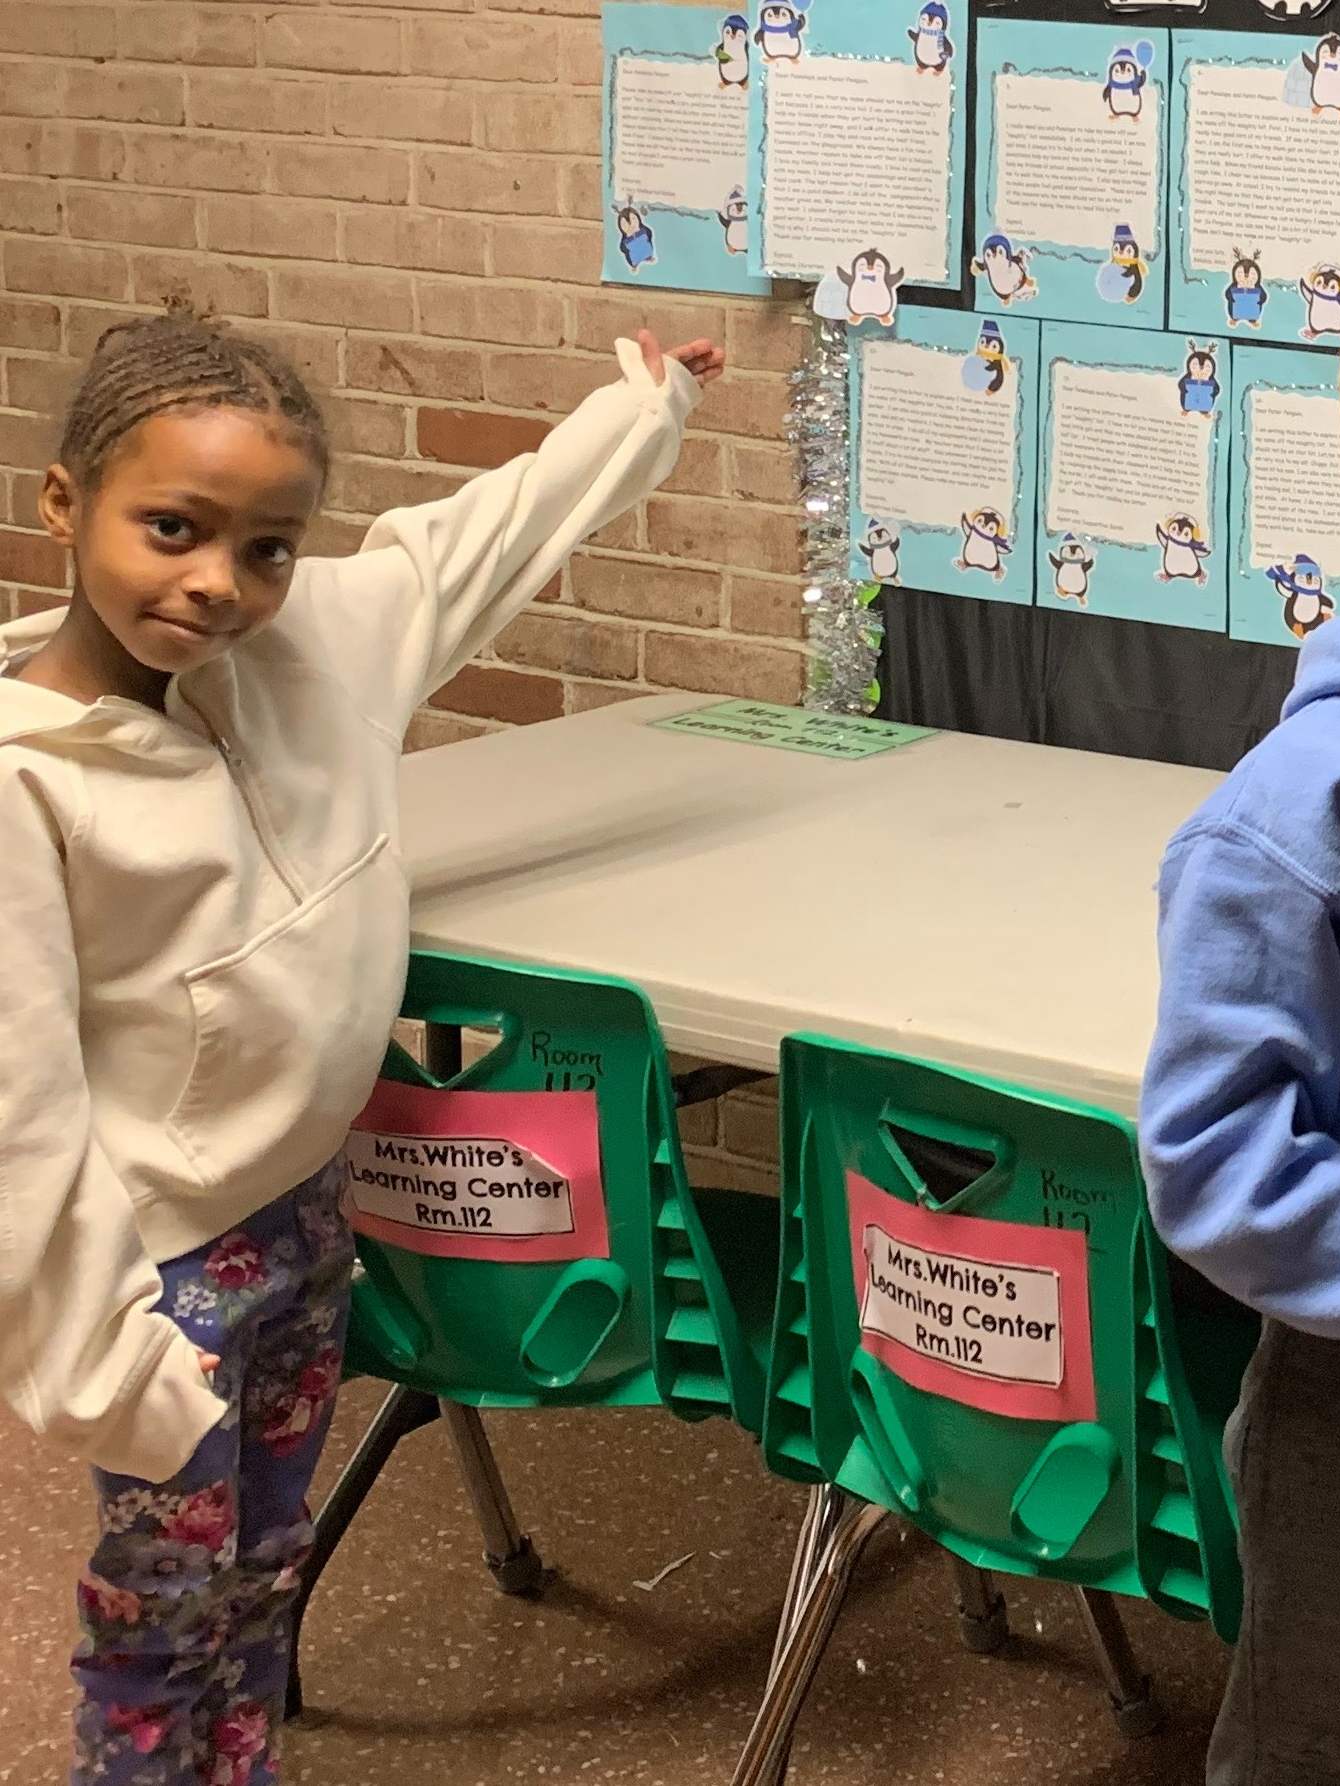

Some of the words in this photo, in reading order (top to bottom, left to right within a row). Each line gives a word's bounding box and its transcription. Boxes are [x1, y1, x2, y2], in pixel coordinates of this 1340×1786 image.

[672, 717, 775, 739] Learning
[781, 736, 866, 753] Center
[532, 1029, 604, 1077] Room
[545, 1072, 596, 1092] 112
[350, 1160, 458, 1201] Learning
[467, 1177, 564, 1199] Center
[1041, 1167, 1117, 1215] Room
[415, 1203, 492, 1228] Rm.112
[870, 1263, 953, 1327] Learning
[963, 1304, 1056, 1342] Center
[916, 1323, 983, 1364] Rm.112
